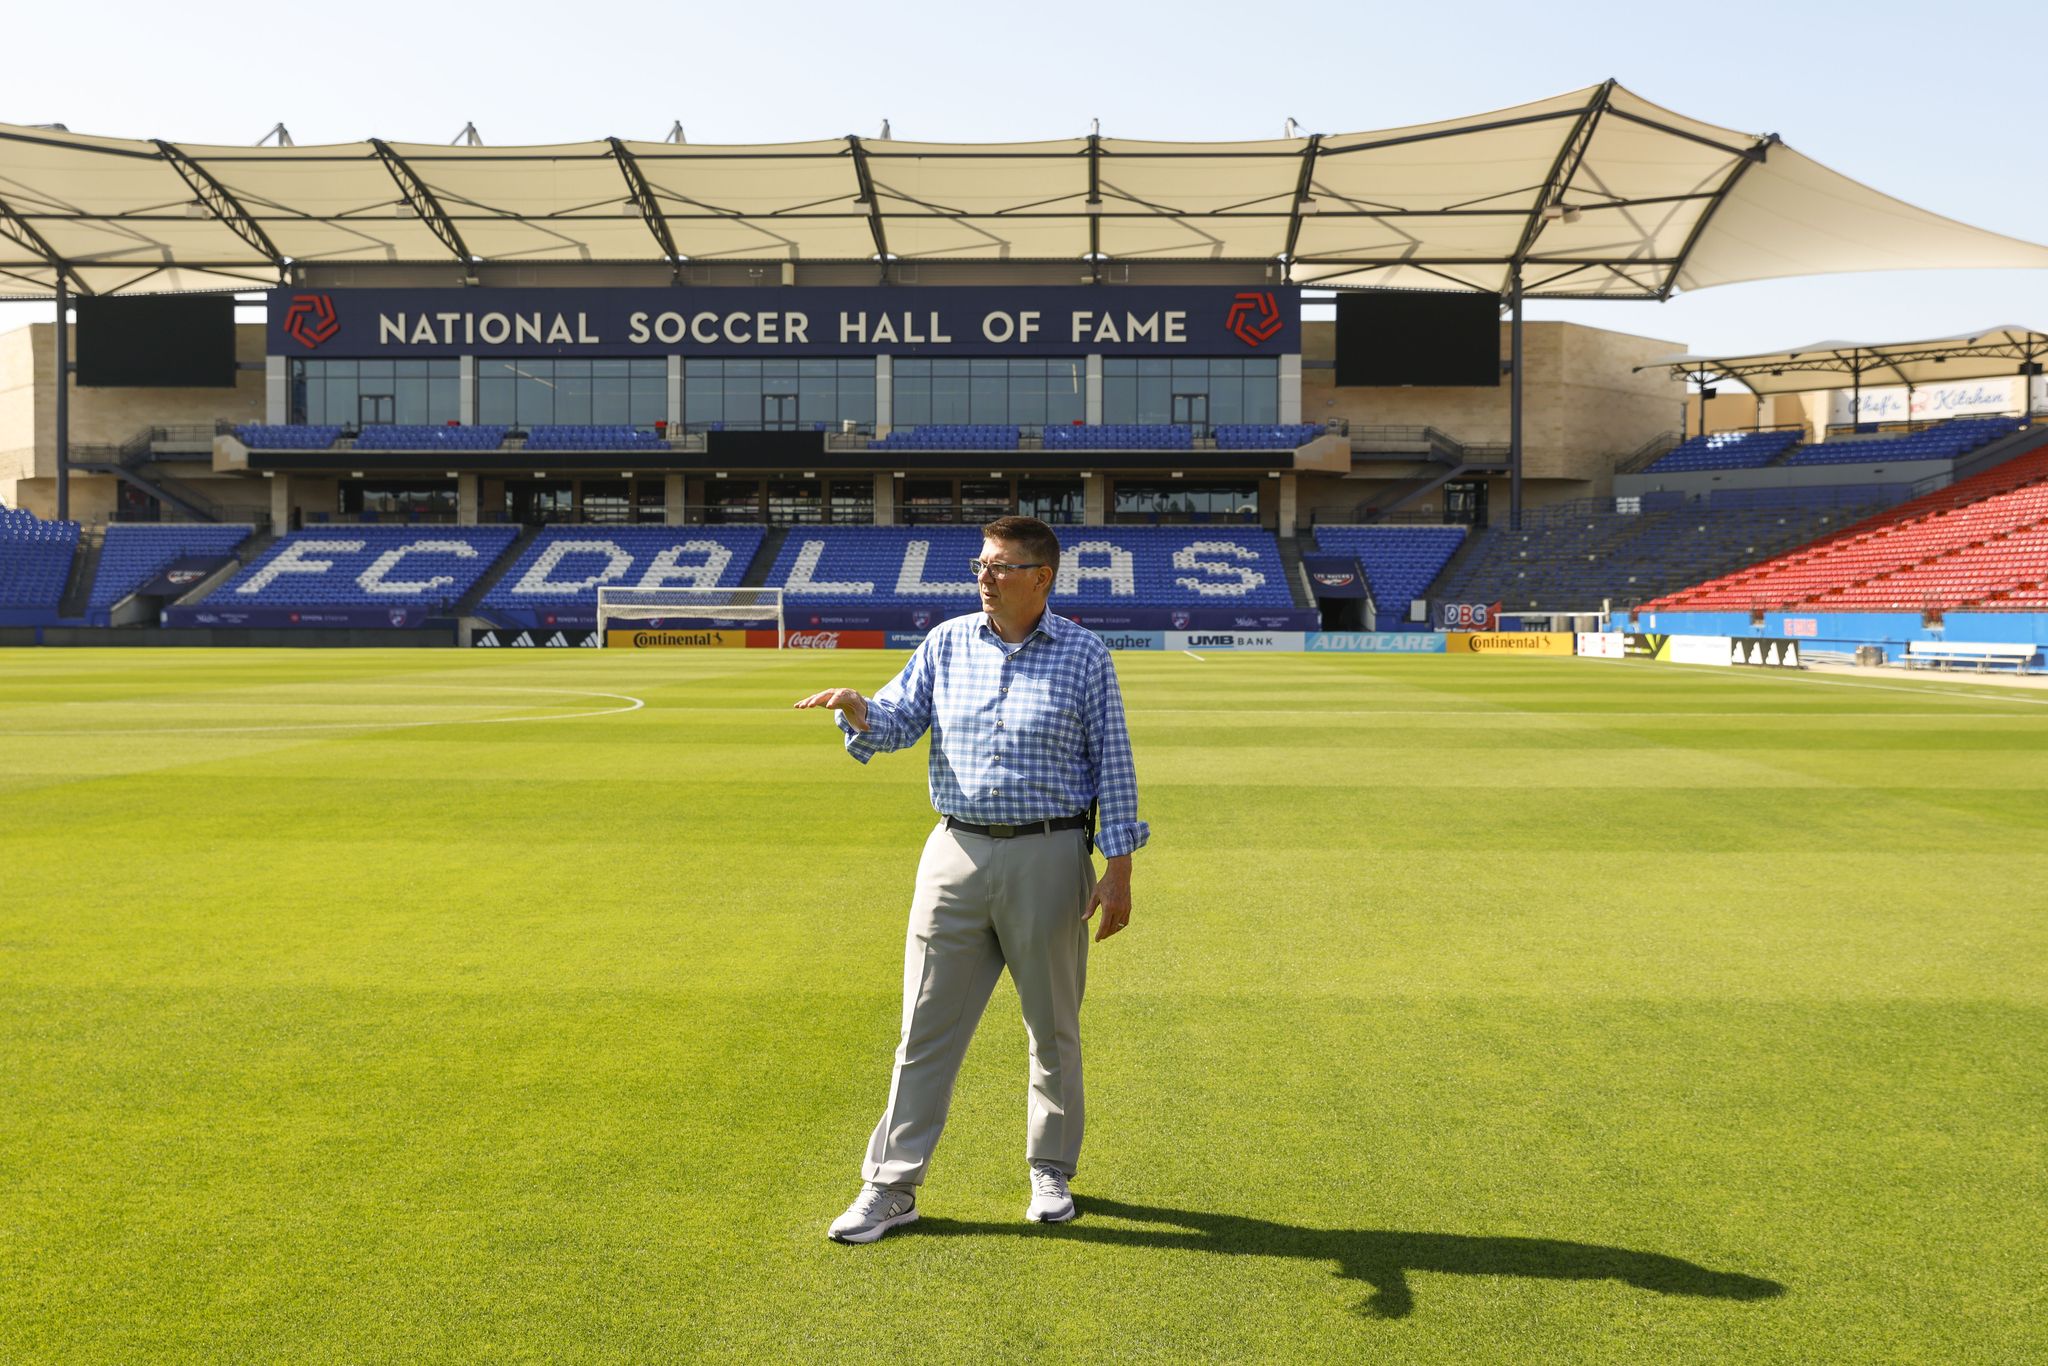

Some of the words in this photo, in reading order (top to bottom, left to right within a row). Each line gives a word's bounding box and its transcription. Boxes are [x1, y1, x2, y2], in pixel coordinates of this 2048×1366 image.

[379, 312, 600, 344] NATIONAL
[628, 311, 809, 344] SOCCER
[840, 311, 952, 343] HALL
[982, 310, 1041, 343] OF
[1072, 311, 1187, 343] FAME
[236, 540, 479, 594] FC
[1444, 603, 1488, 626] DBG
[633, 632, 711, 648] Continental
[1187, 635, 1235, 646] UMB
[1237, 637, 1273, 646] BANK
[1312, 634, 1439, 650] ADVOCARE
[1468, 634, 1540, 652] Continental
